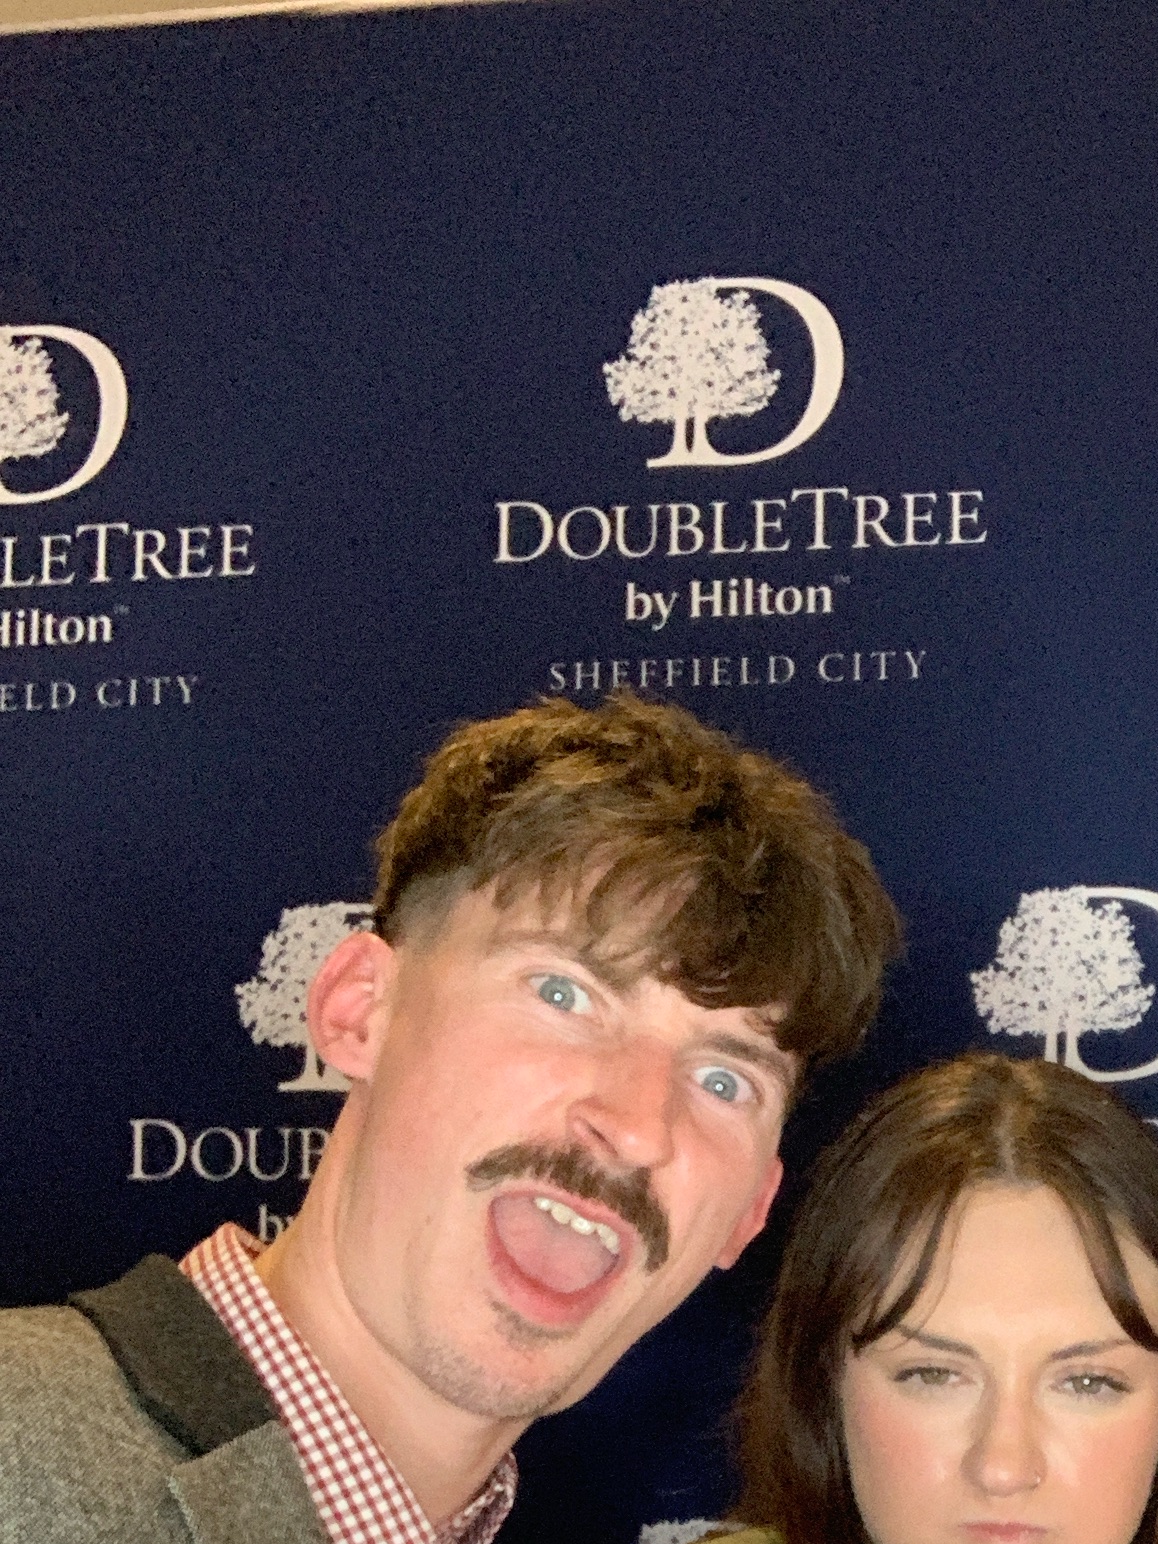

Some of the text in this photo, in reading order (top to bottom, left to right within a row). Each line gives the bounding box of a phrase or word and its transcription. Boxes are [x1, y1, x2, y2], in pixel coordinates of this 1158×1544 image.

[493, 487, 988, 564] DOUBLETREE
[0, 522, 257, 589] LETREE
[624, 582, 679, 631] by
[97, 675, 199, 708] CITY
[549, 649, 928, 691] SHEFFIELD CITY
